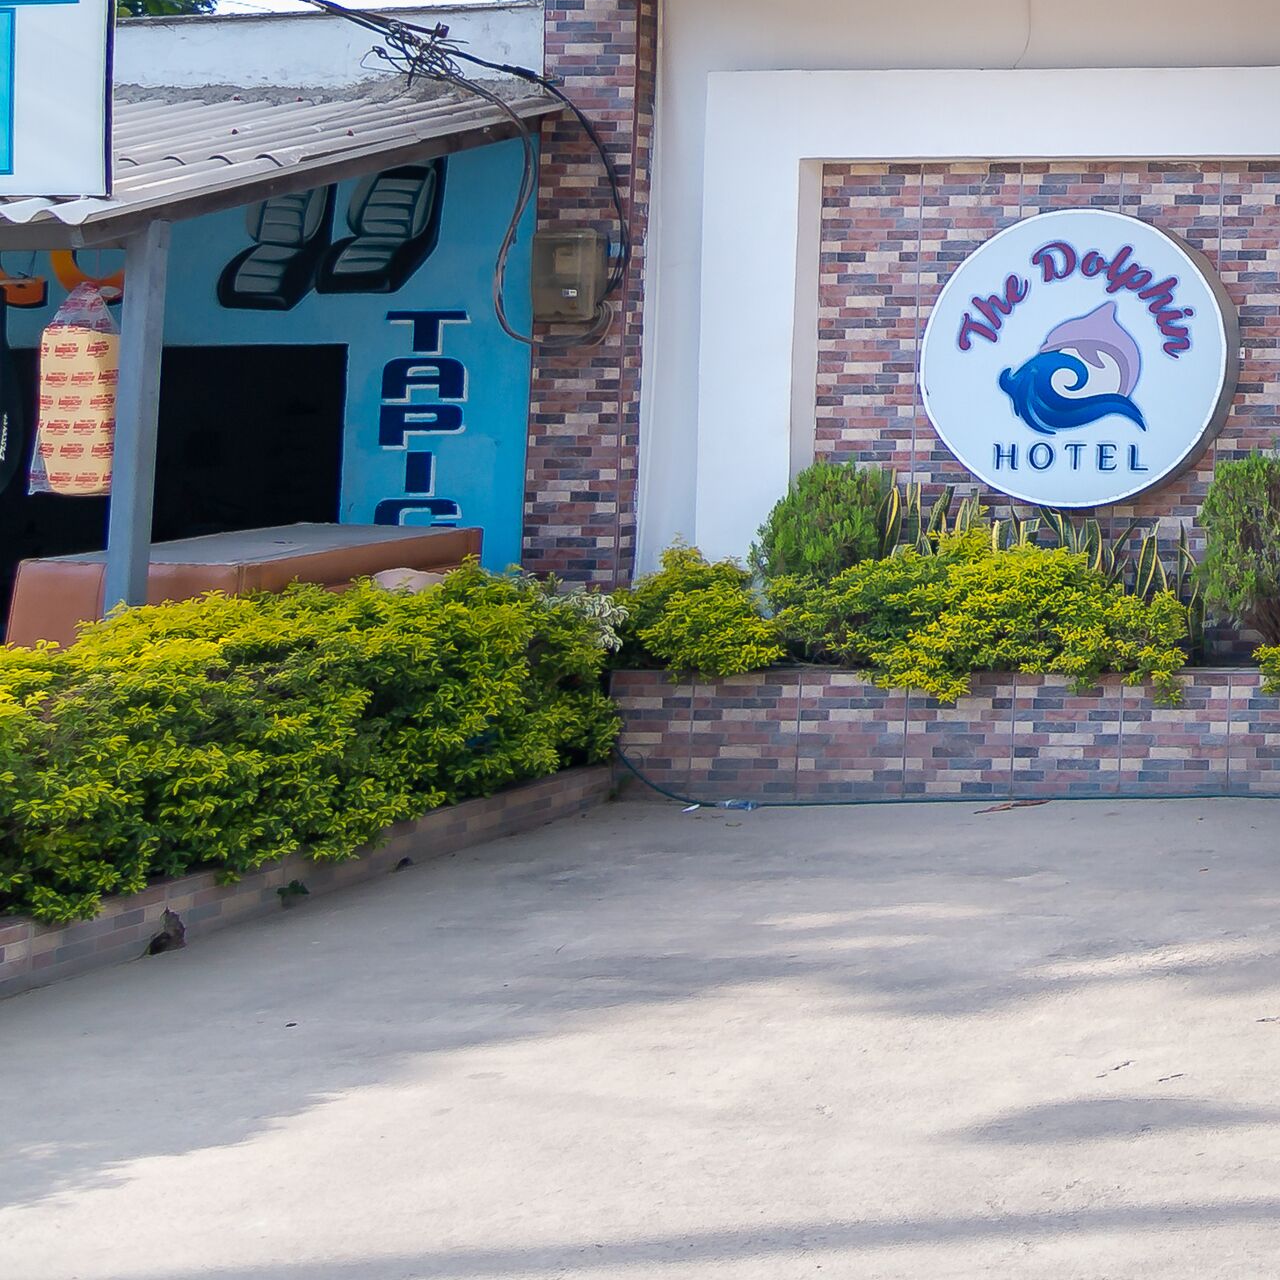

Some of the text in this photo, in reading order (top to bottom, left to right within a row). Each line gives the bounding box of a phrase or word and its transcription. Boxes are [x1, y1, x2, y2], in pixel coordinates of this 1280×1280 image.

[959, 241, 1194, 359] The Dolphin
[993, 442, 1149, 471] HOTEL
